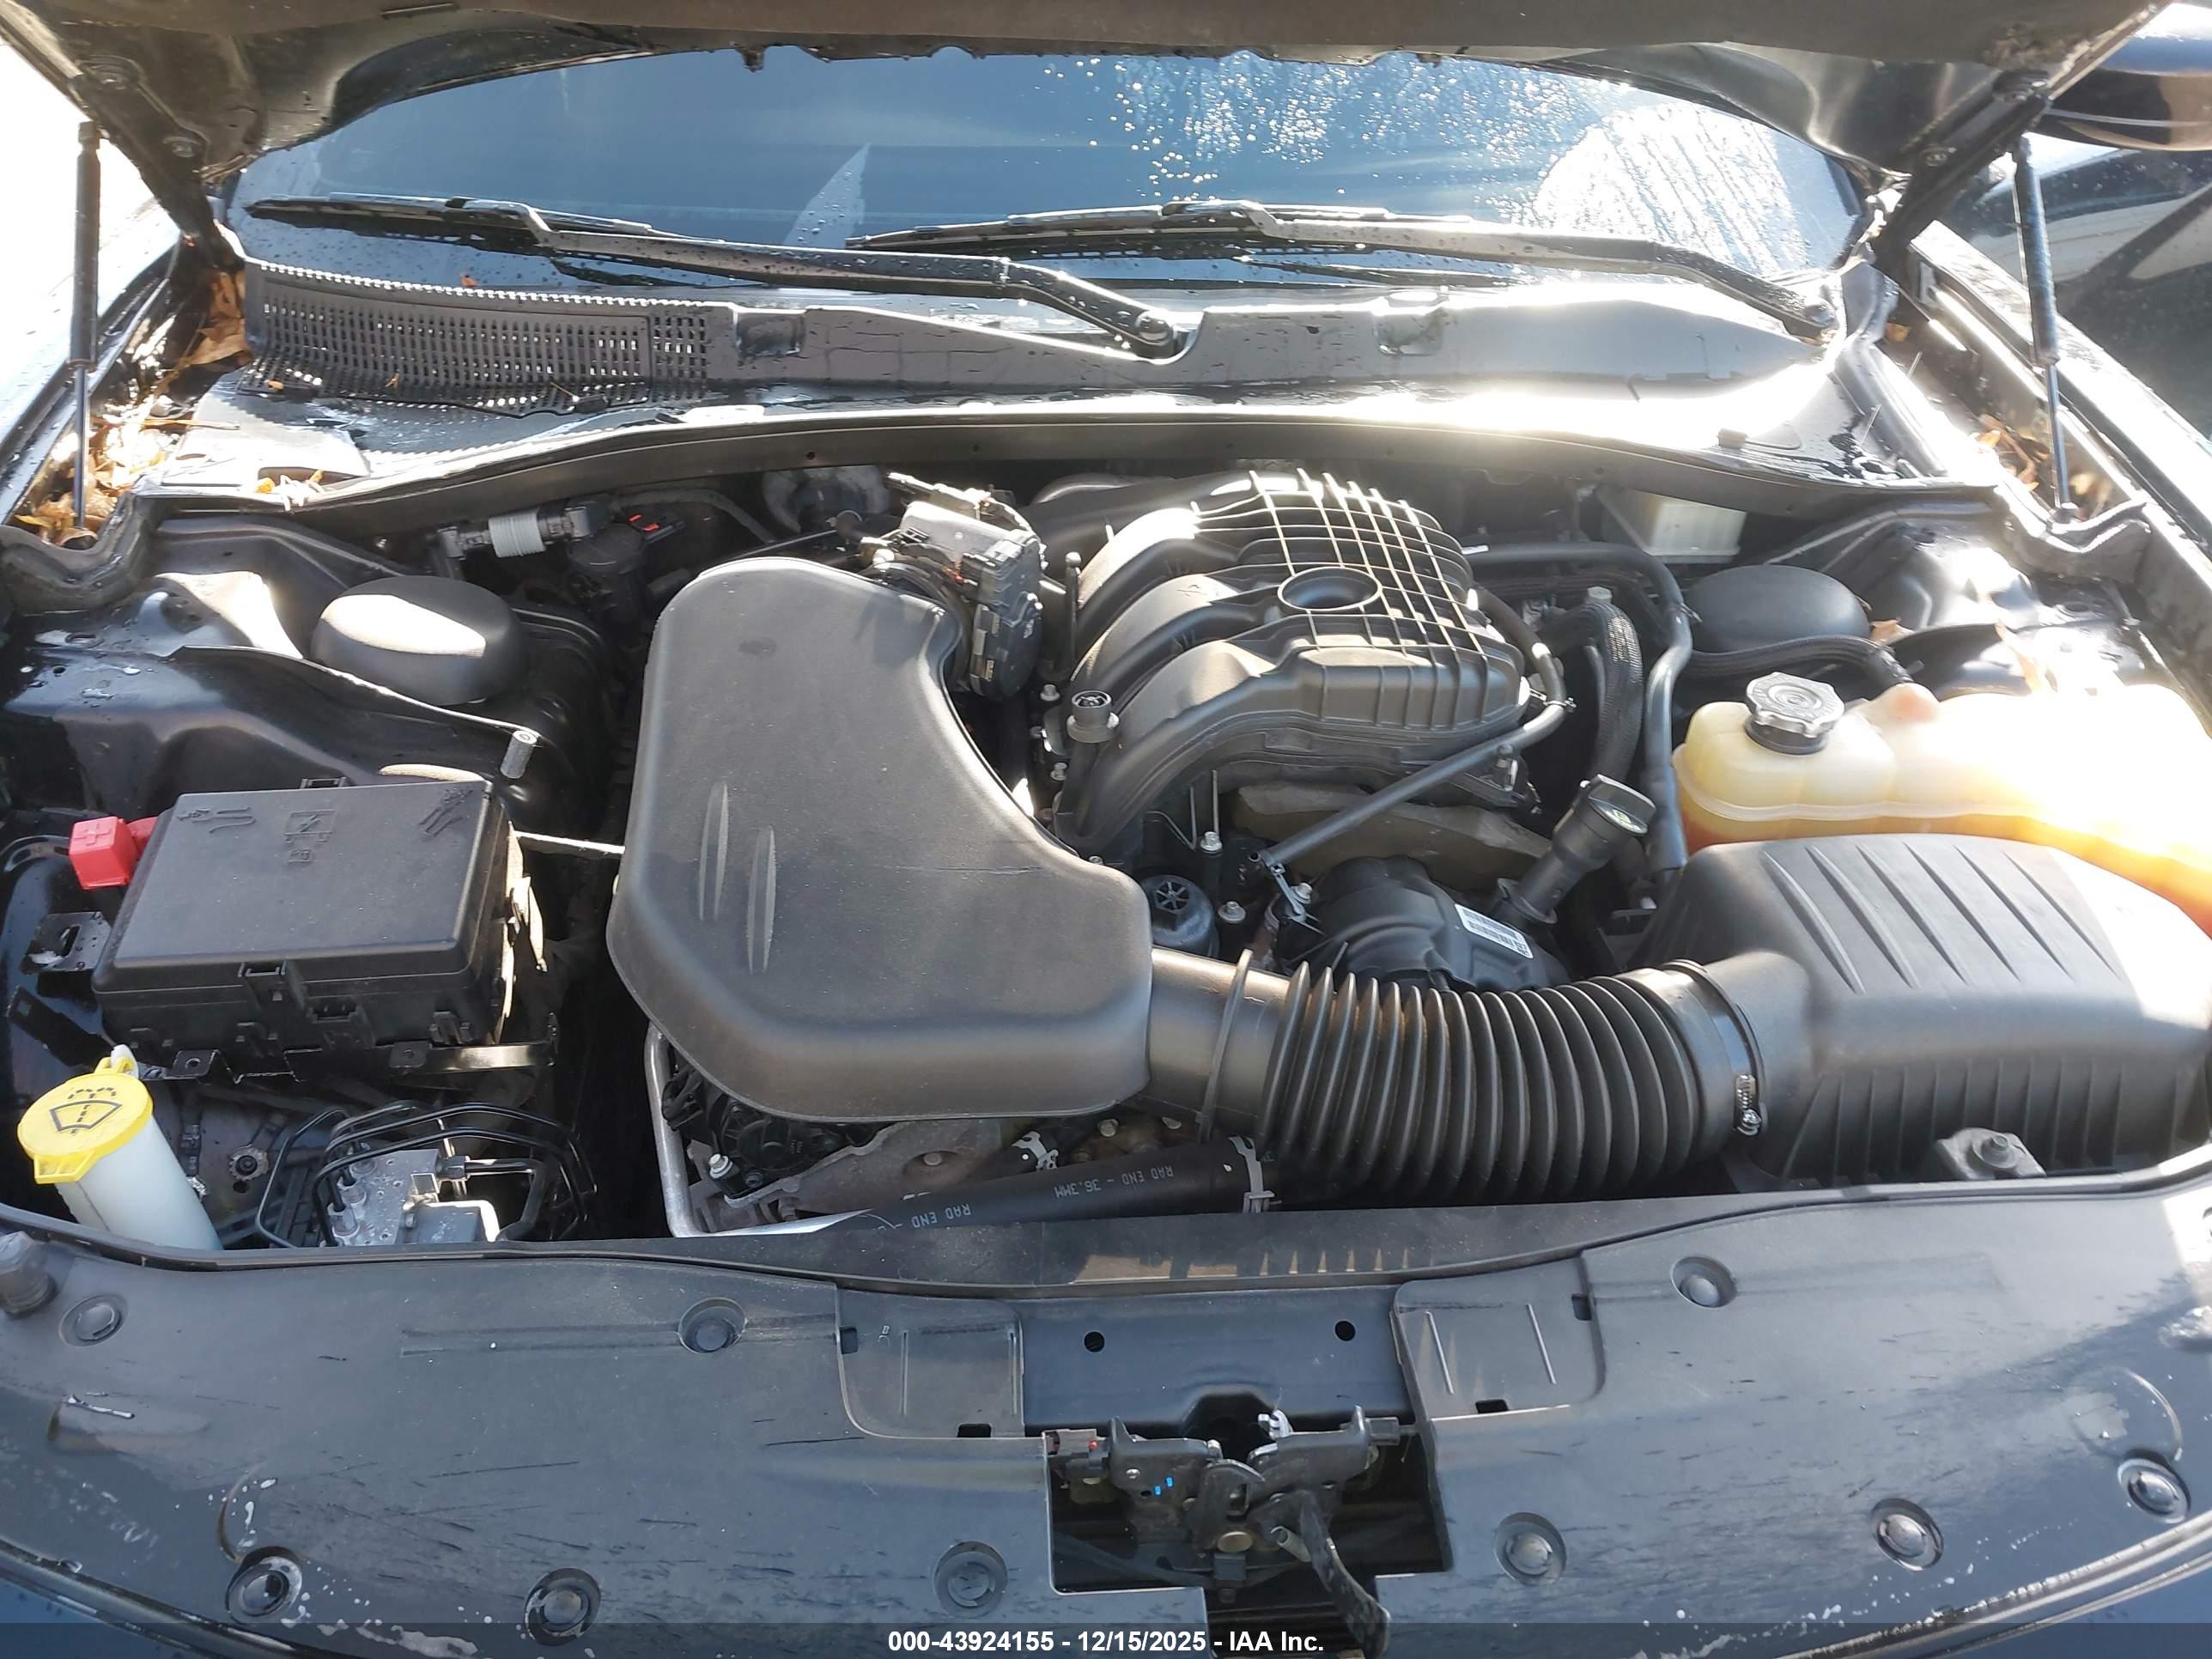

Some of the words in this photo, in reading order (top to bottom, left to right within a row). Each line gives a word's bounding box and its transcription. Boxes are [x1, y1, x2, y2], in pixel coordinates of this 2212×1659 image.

[1121, 1170, 1145, 1185] END
[1152, 1165, 1174, 1180] RAD
[1054, 1178, 1102, 1198] 36.3MM
[945, 1203, 971, 1219] RAD
[911, 1211, 938, 1229] END
